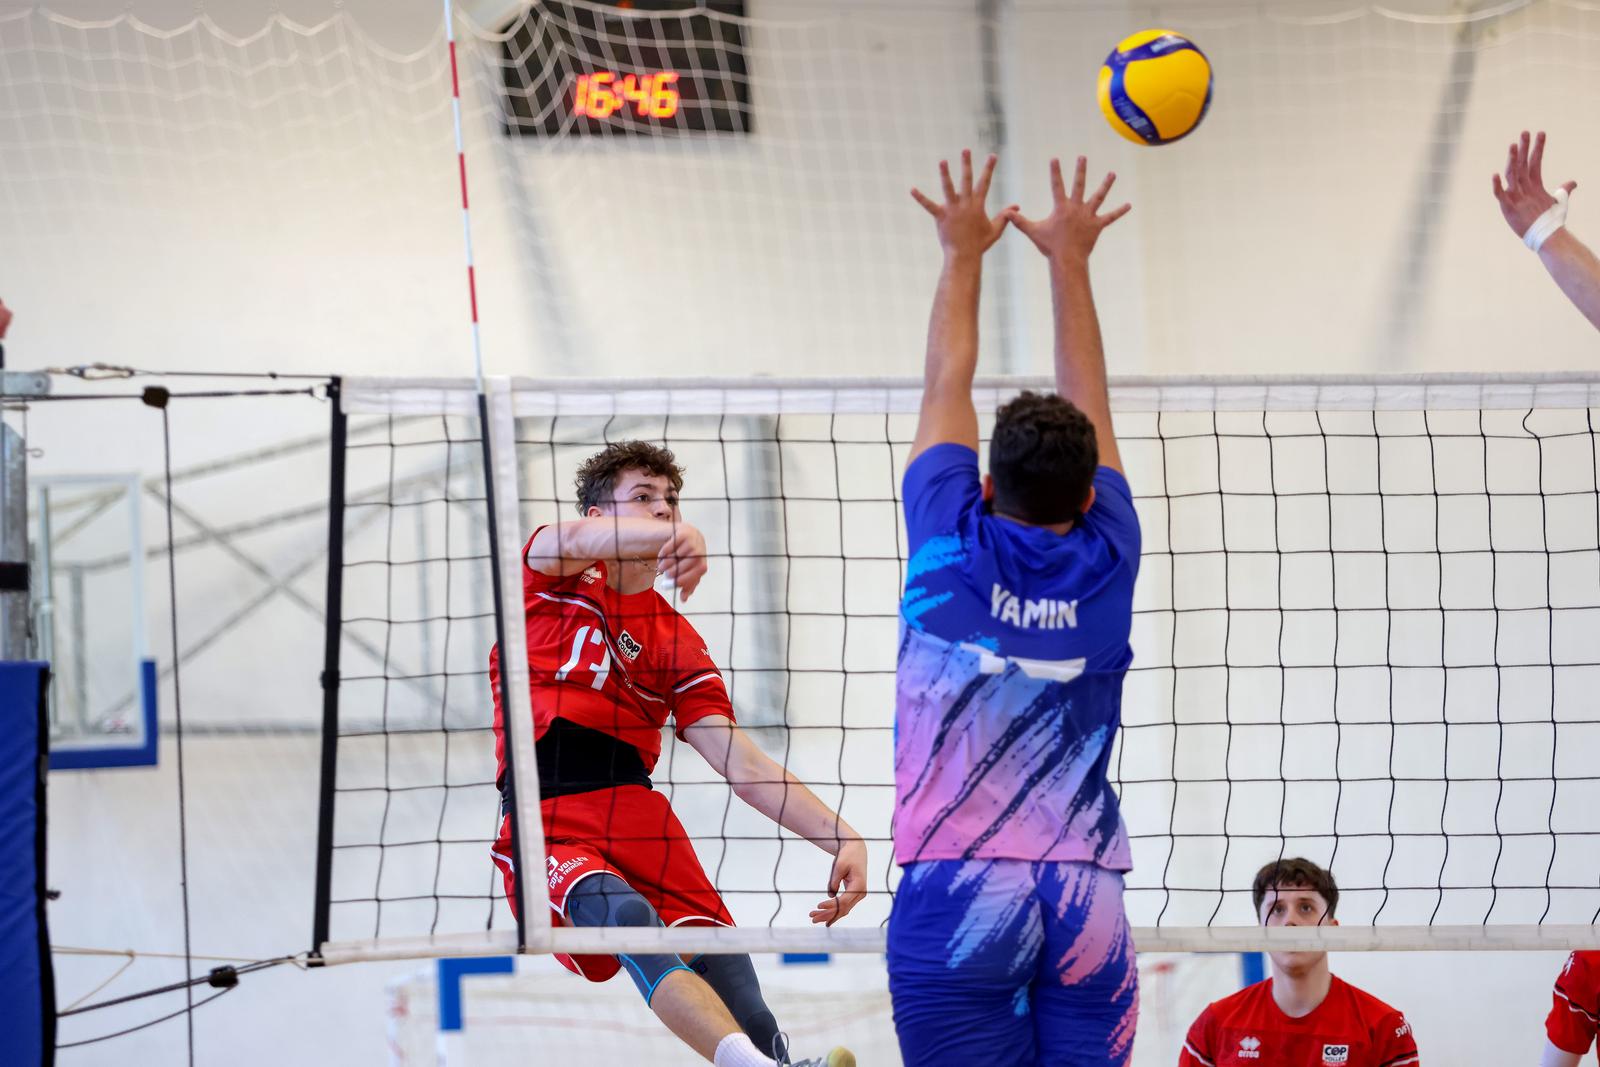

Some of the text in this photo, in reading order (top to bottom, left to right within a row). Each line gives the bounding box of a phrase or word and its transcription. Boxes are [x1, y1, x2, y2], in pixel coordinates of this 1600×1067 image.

[575, 72, 679, 119] 16:46
[990, 582, 1078, 630] YAMIN
[621, 633, 640, 653] COP
[1325, 1046, 1347, 1056] COP
